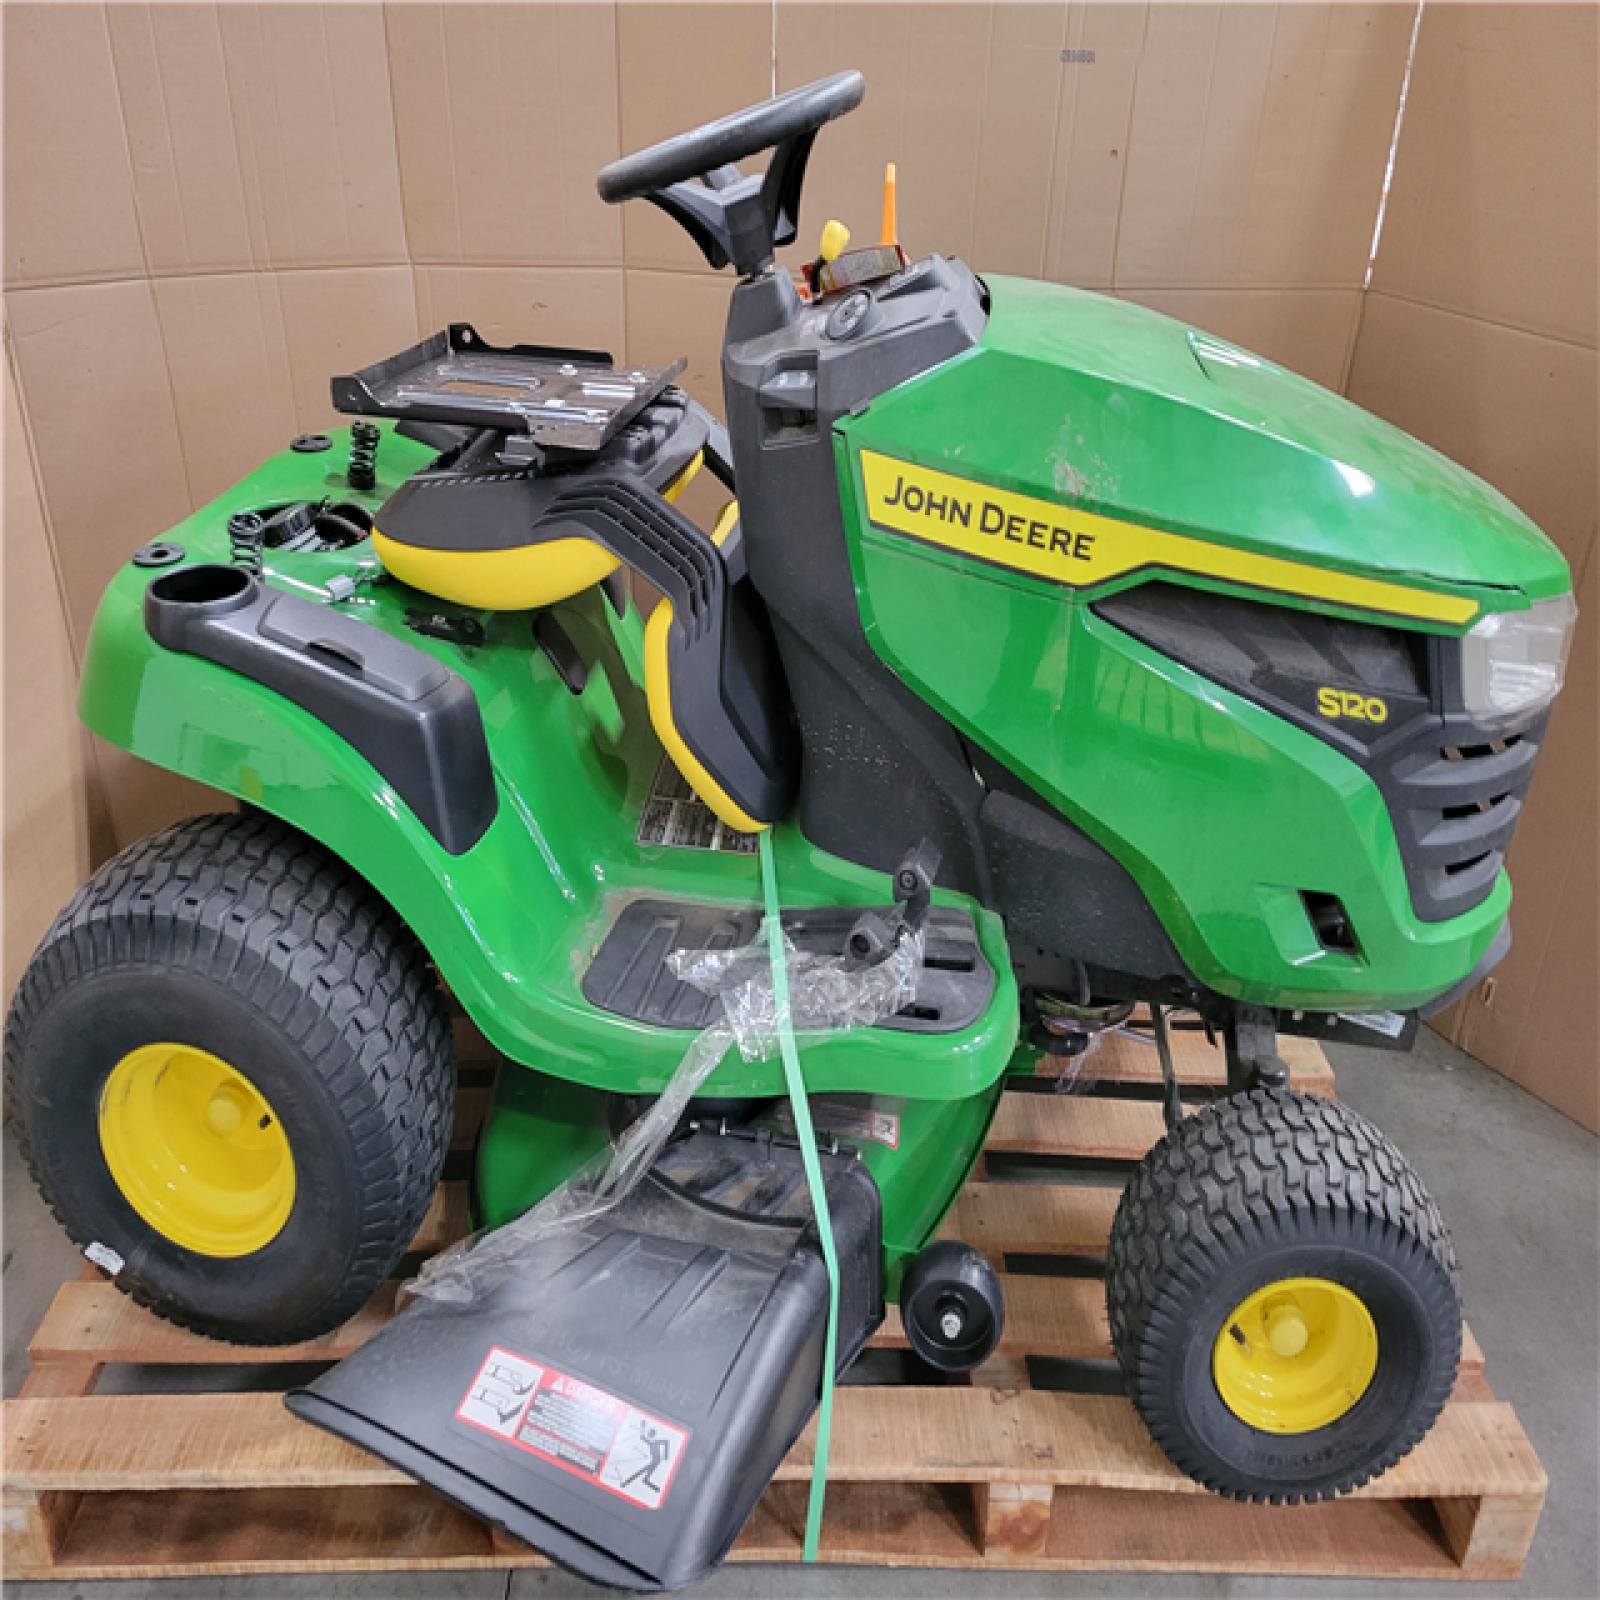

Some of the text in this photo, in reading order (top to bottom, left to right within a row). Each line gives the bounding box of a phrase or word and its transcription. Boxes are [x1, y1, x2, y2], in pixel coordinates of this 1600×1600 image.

[884, 476, 1096, 561] JOHN DEERE
[1317, 687, 1388, 723] S120
